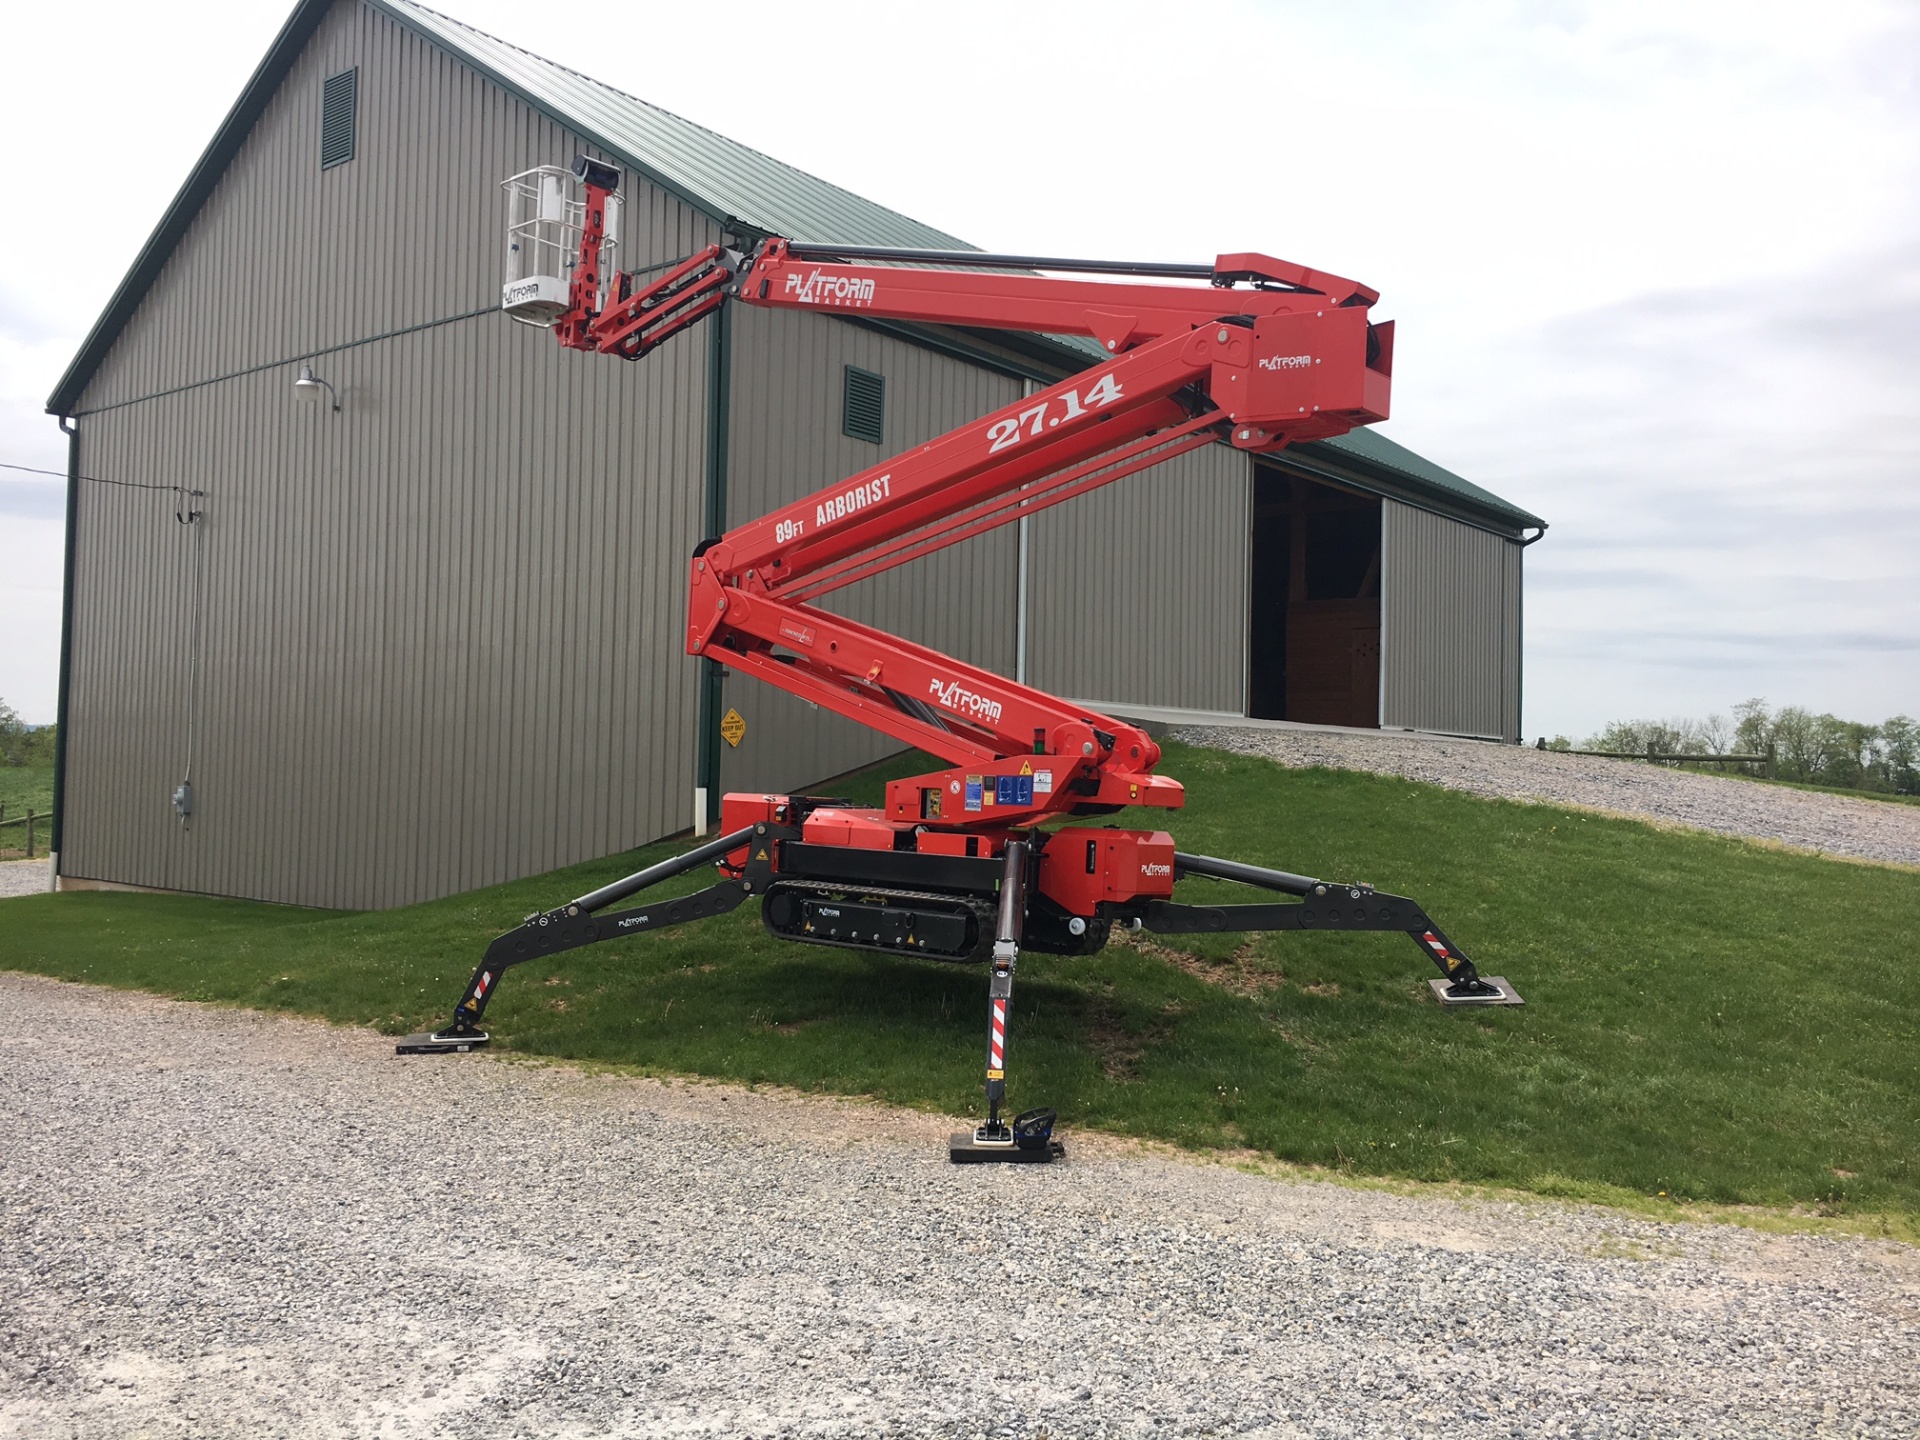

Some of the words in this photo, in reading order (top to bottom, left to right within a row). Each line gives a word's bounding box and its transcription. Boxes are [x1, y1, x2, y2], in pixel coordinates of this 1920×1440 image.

[785, 267, 875, 303] PLATFORM
[814, 296, 872, 308] BASKET
[1259, 355, 1311, 370] PLATFORM
[987, 373, 1125, 454] 27.14
[816, 474, 891, 527] ARBORIST
[929, 678, 1002, 720] PLATFORM
[952, 703, 999, 725] BASKET
[1141, 862, 1170, 876] PLATFORM
